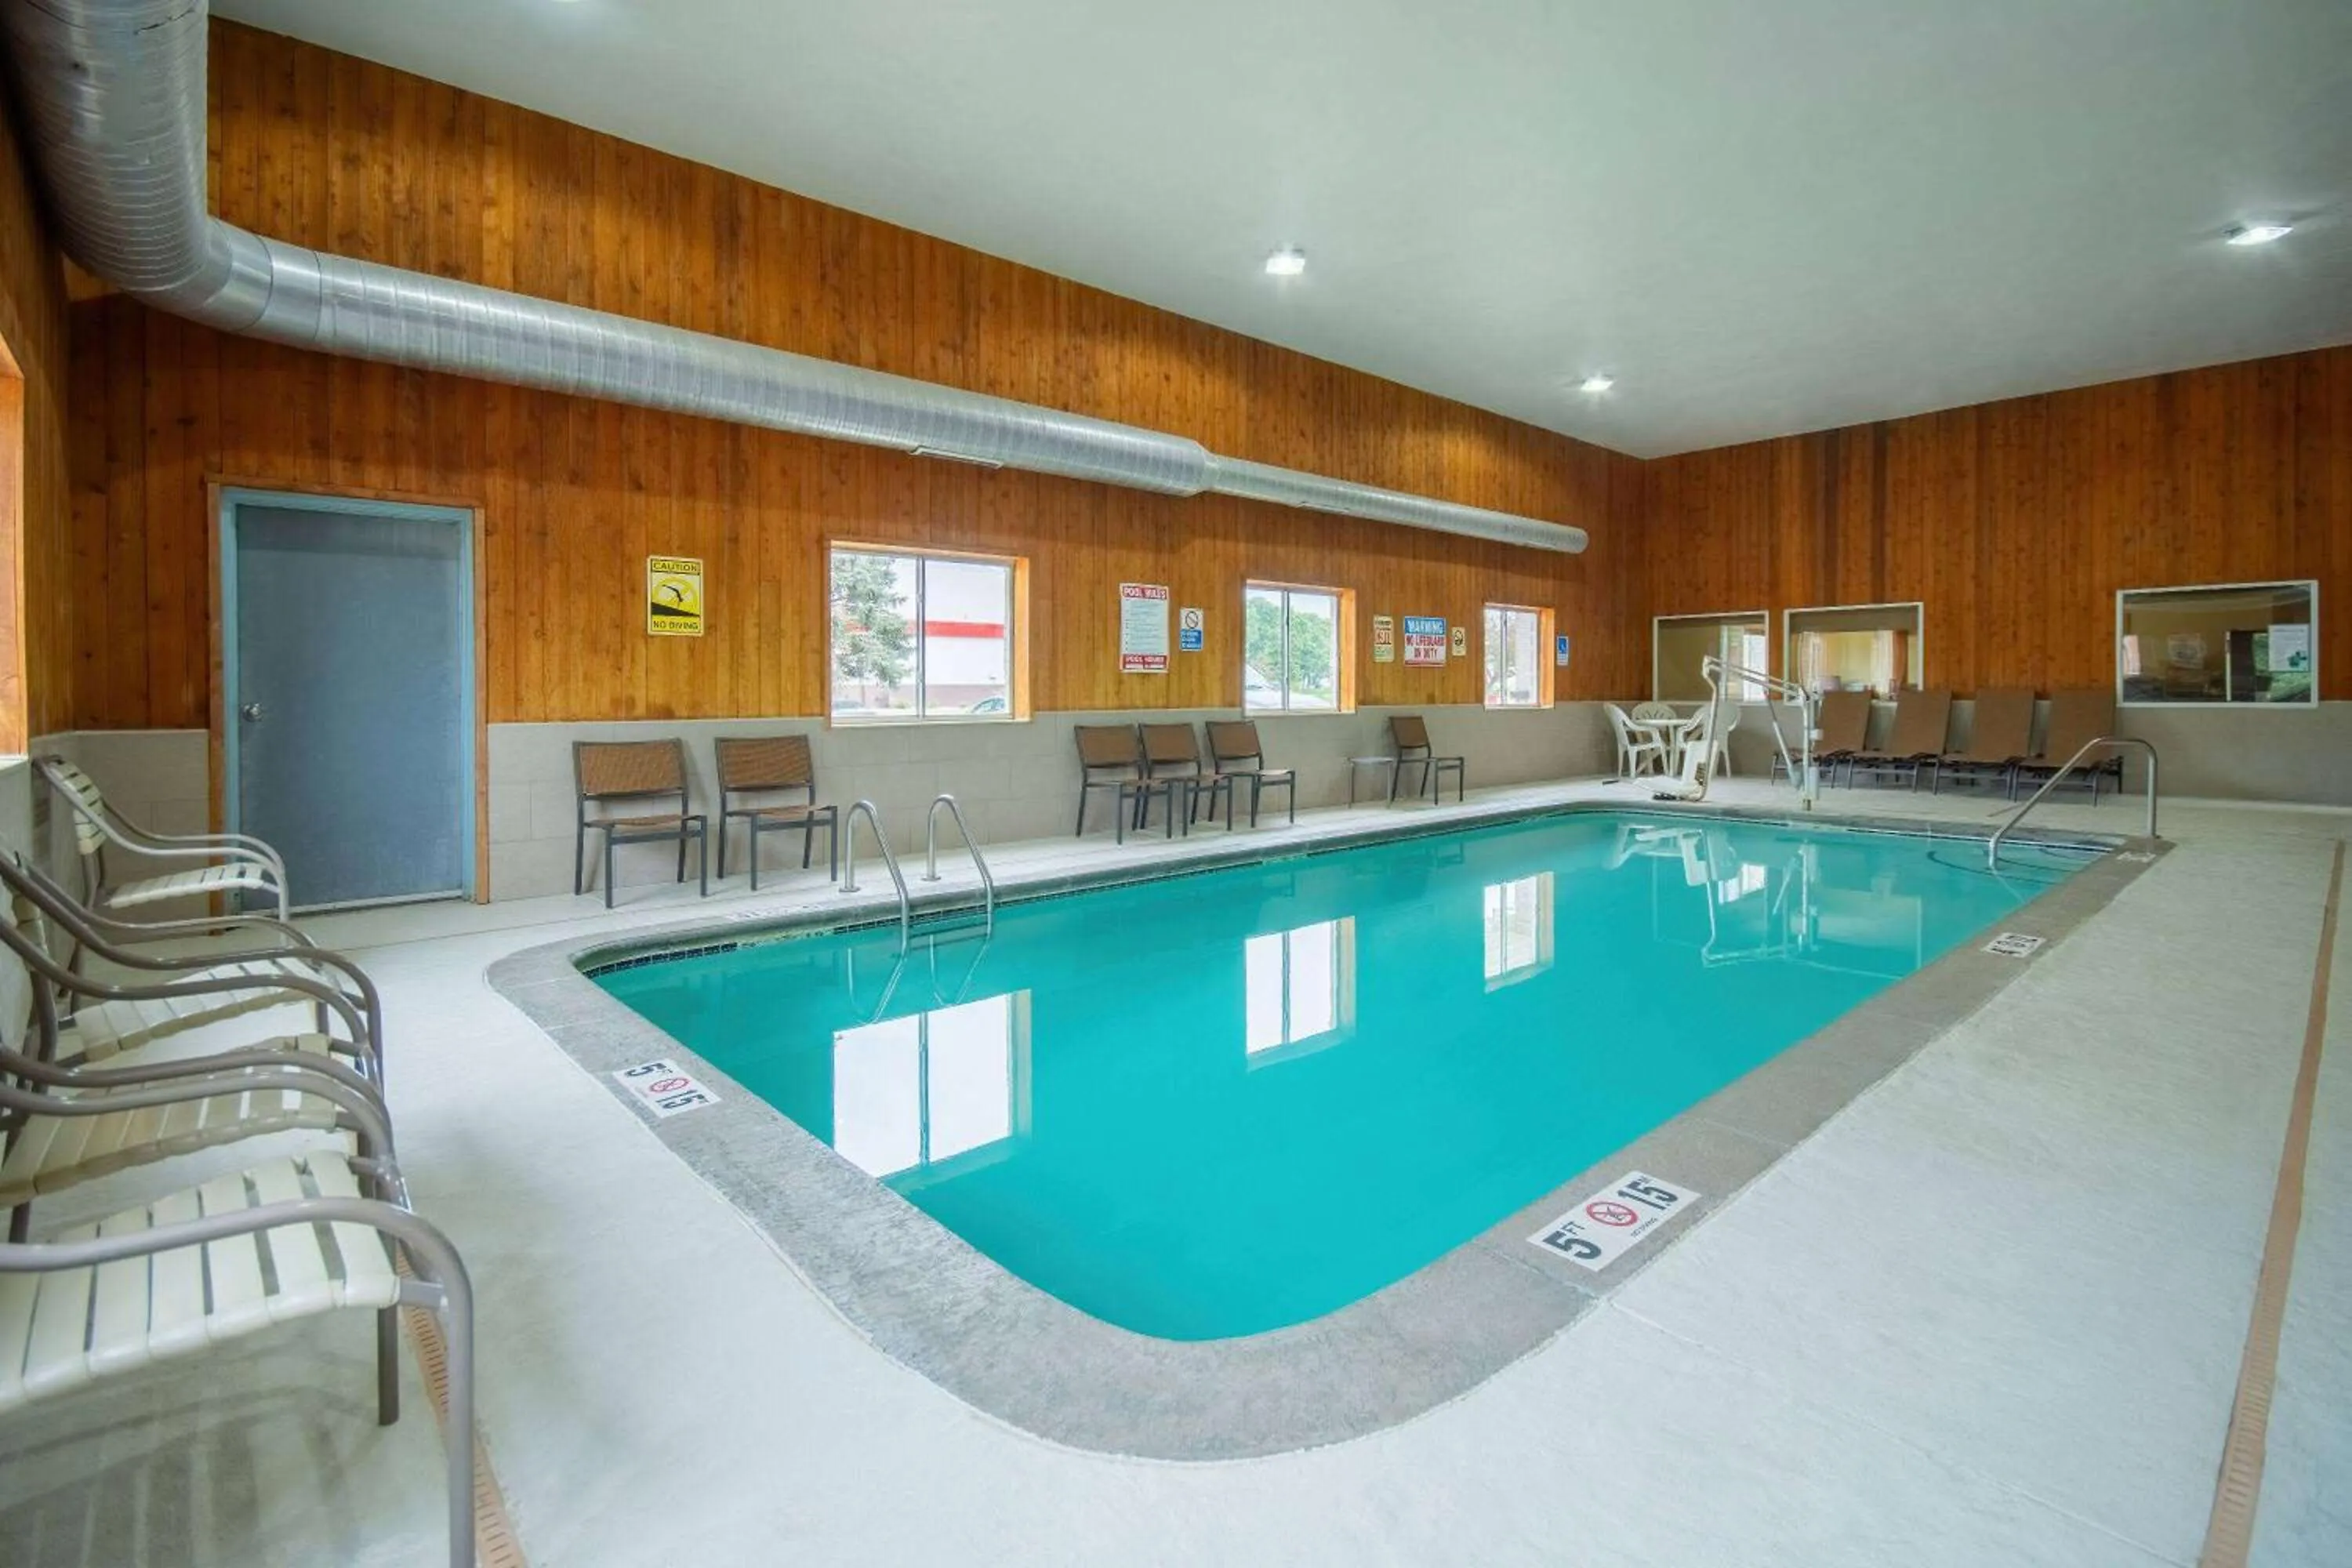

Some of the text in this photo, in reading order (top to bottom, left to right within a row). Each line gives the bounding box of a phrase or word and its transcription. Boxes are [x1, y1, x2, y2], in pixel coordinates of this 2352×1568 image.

[653, 562, 697, 572] CAUTION
[625, 1062, 667, 1076] 5
[1561, 1221, 1585, 1236] FT
[1542, 1230, 1602, 1259] 5
